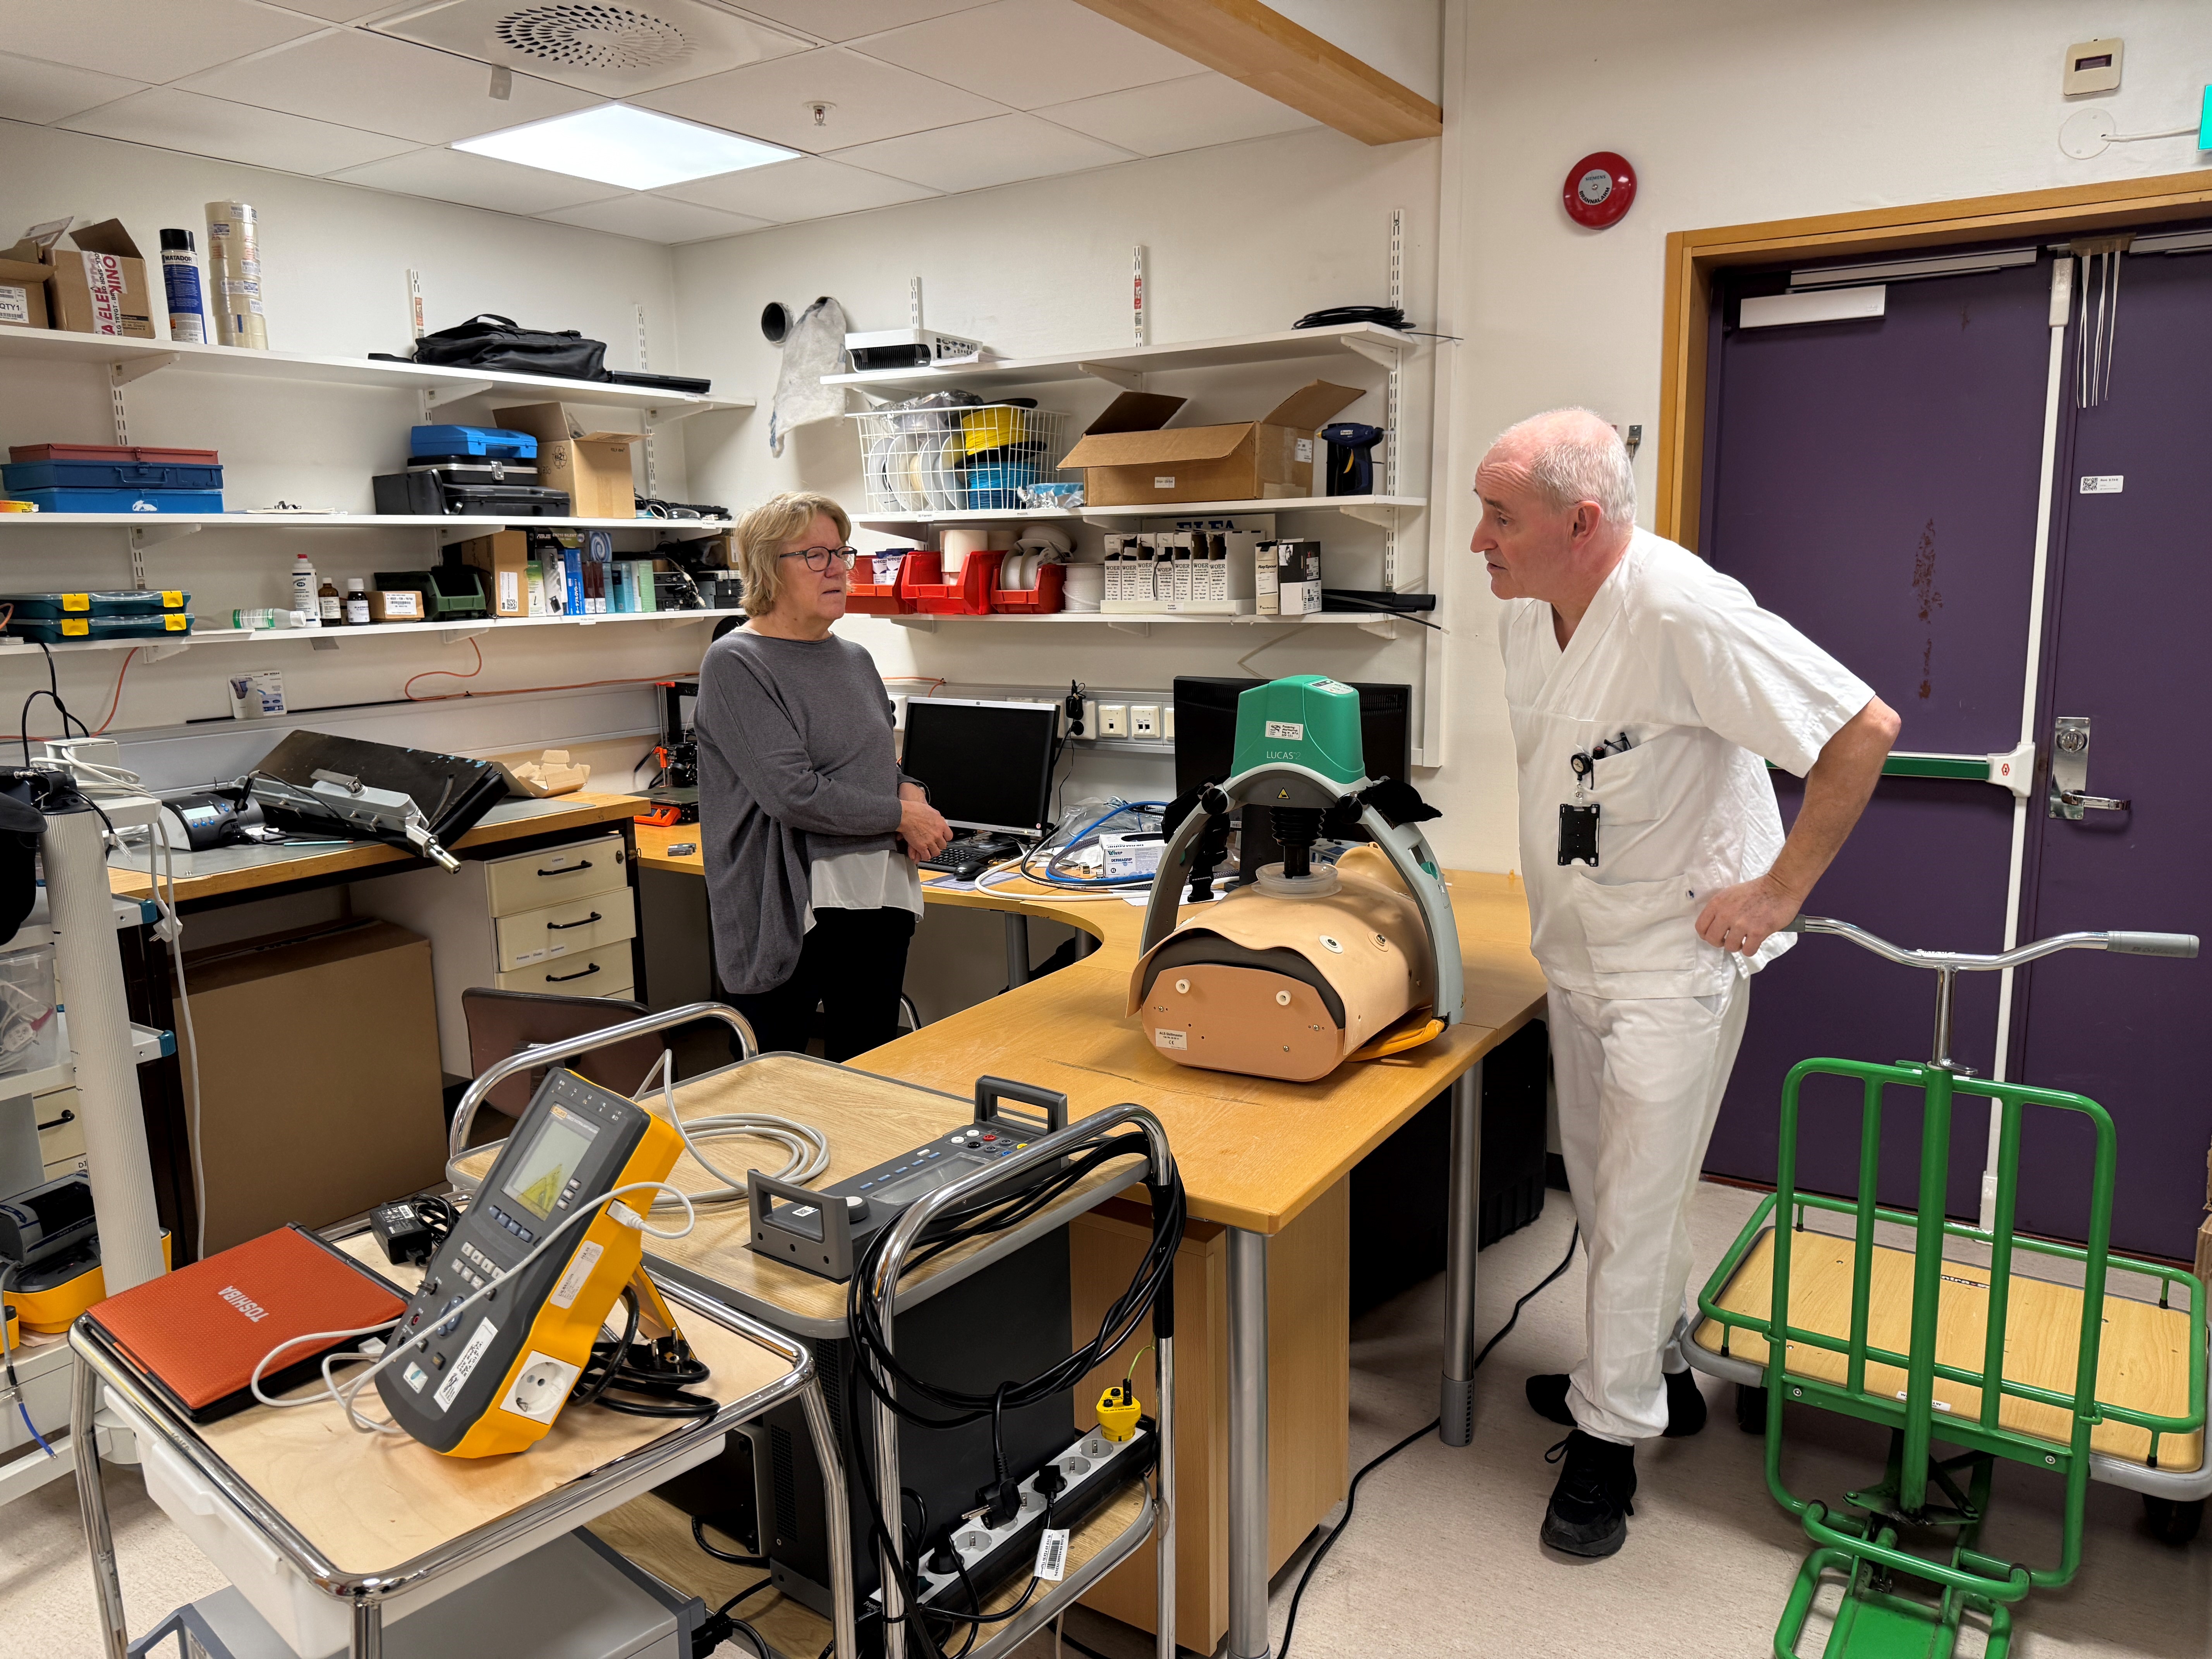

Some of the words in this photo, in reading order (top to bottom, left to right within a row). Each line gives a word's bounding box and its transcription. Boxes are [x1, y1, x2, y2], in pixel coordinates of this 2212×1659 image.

[1579, 187, 1610, 204] BRANNALARM
[1267, 751, 1293, 759] LUCAS
[218, 1285, 270, 1322] TOSHIBA
